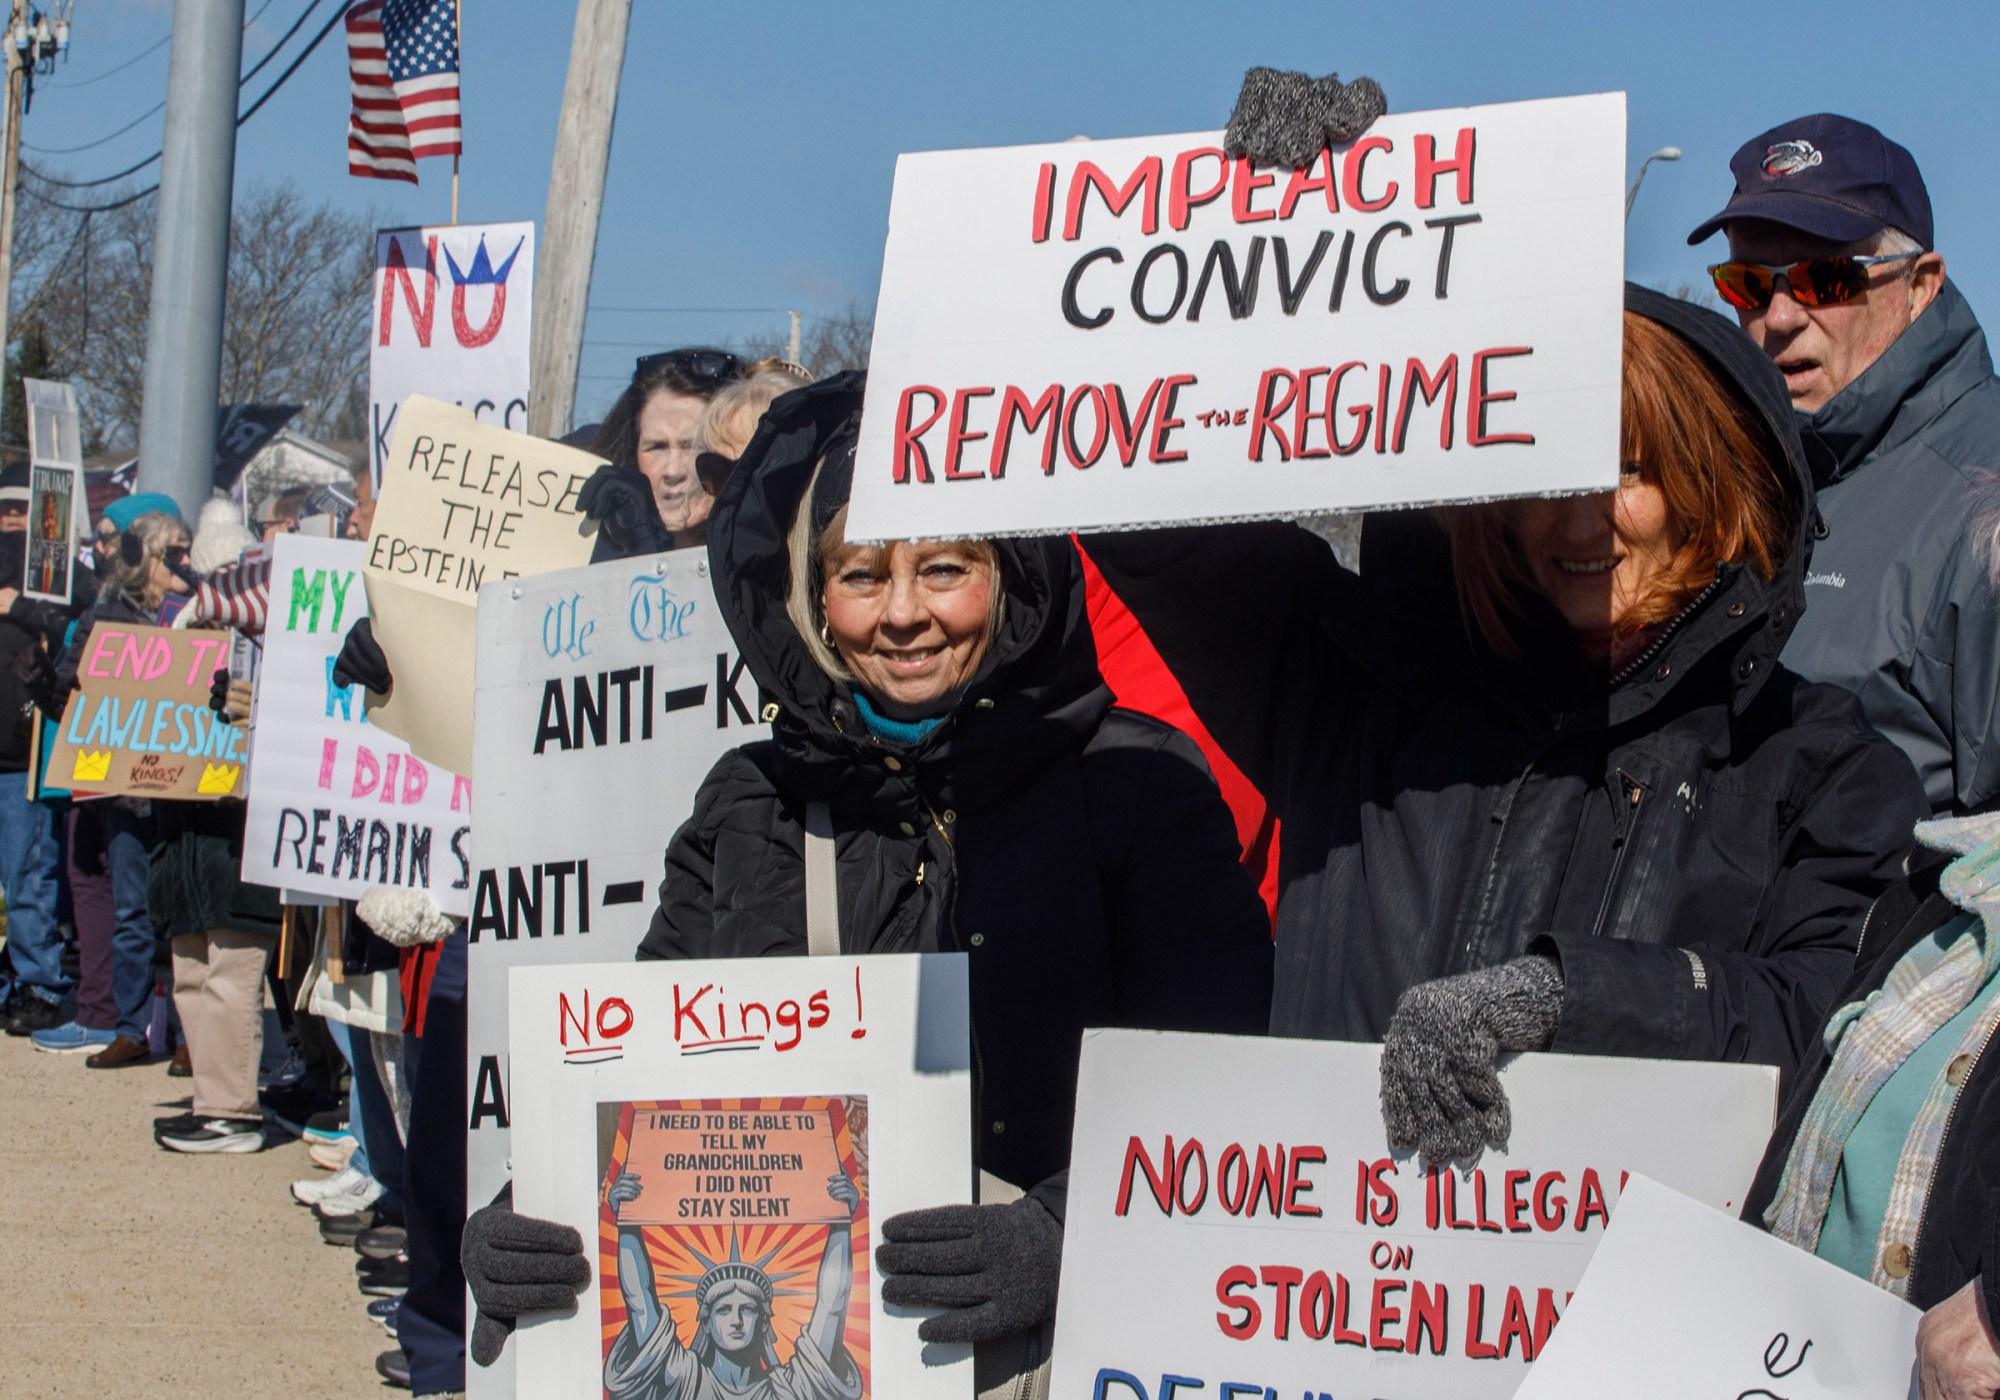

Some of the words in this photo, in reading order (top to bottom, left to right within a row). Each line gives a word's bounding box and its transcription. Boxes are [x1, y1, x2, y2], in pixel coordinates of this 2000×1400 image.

[1032, 127, 1476, 242] IMPEACH
[1061, 213, 1482, 329] CONVICT
[893, 374, 1197, 484] REMOVE
[1196, 408, 1249, 428] THE
[1248, 347, 1535, 462] REGIME
[35, 469, 73, 494] TRUMP
[409, 436, 590, 515] RELEASE
[442, 499, 523, 549] THE
[369, 534, 485, 592] EPSTEIN
[286, 567, 356, 634] MY
[629, 574, 696, 643] The
[86, 631, 173, 681] END
[67, 694, 249, 763] LAWLESSNE
[533, 652, 770, 755] ANTI-K
[318, 738, 338, 790] I
[351, 746, 428, 805] DID
[272, 808, 433, 889] REMAIN
[650, 1115, 655, 1129] I
[659, 1115, 700, 1129] NEED
[705, 1115, 724, 1130] TO
[729, 1115, 748, 1130] BE
[752, 1115, 792, 1130] ABLE
[795, 1116, 815, 1130] TO
[700, 1134, 738, 1149] TELL
[742, 1135, 767, 1150] MY
[663, 1154, 803, 1170] GRANDCHILDREN
[696, 1176, 700, 1192] I
[706, 1176, 734, 1192] DID
[739, 1176, 772, 1192] NOT
[1356, 1159, 1400, 1226] IS
[1425, 1166, 1630, 1232] ILLEGA
[678, 1199, 725, 1217] STAY
[730, 1198, 790, 1217] SILENT
[1370, 1241, 1413, 1270] ON
[1215, 1266, 1449, 1355] STOLEN
